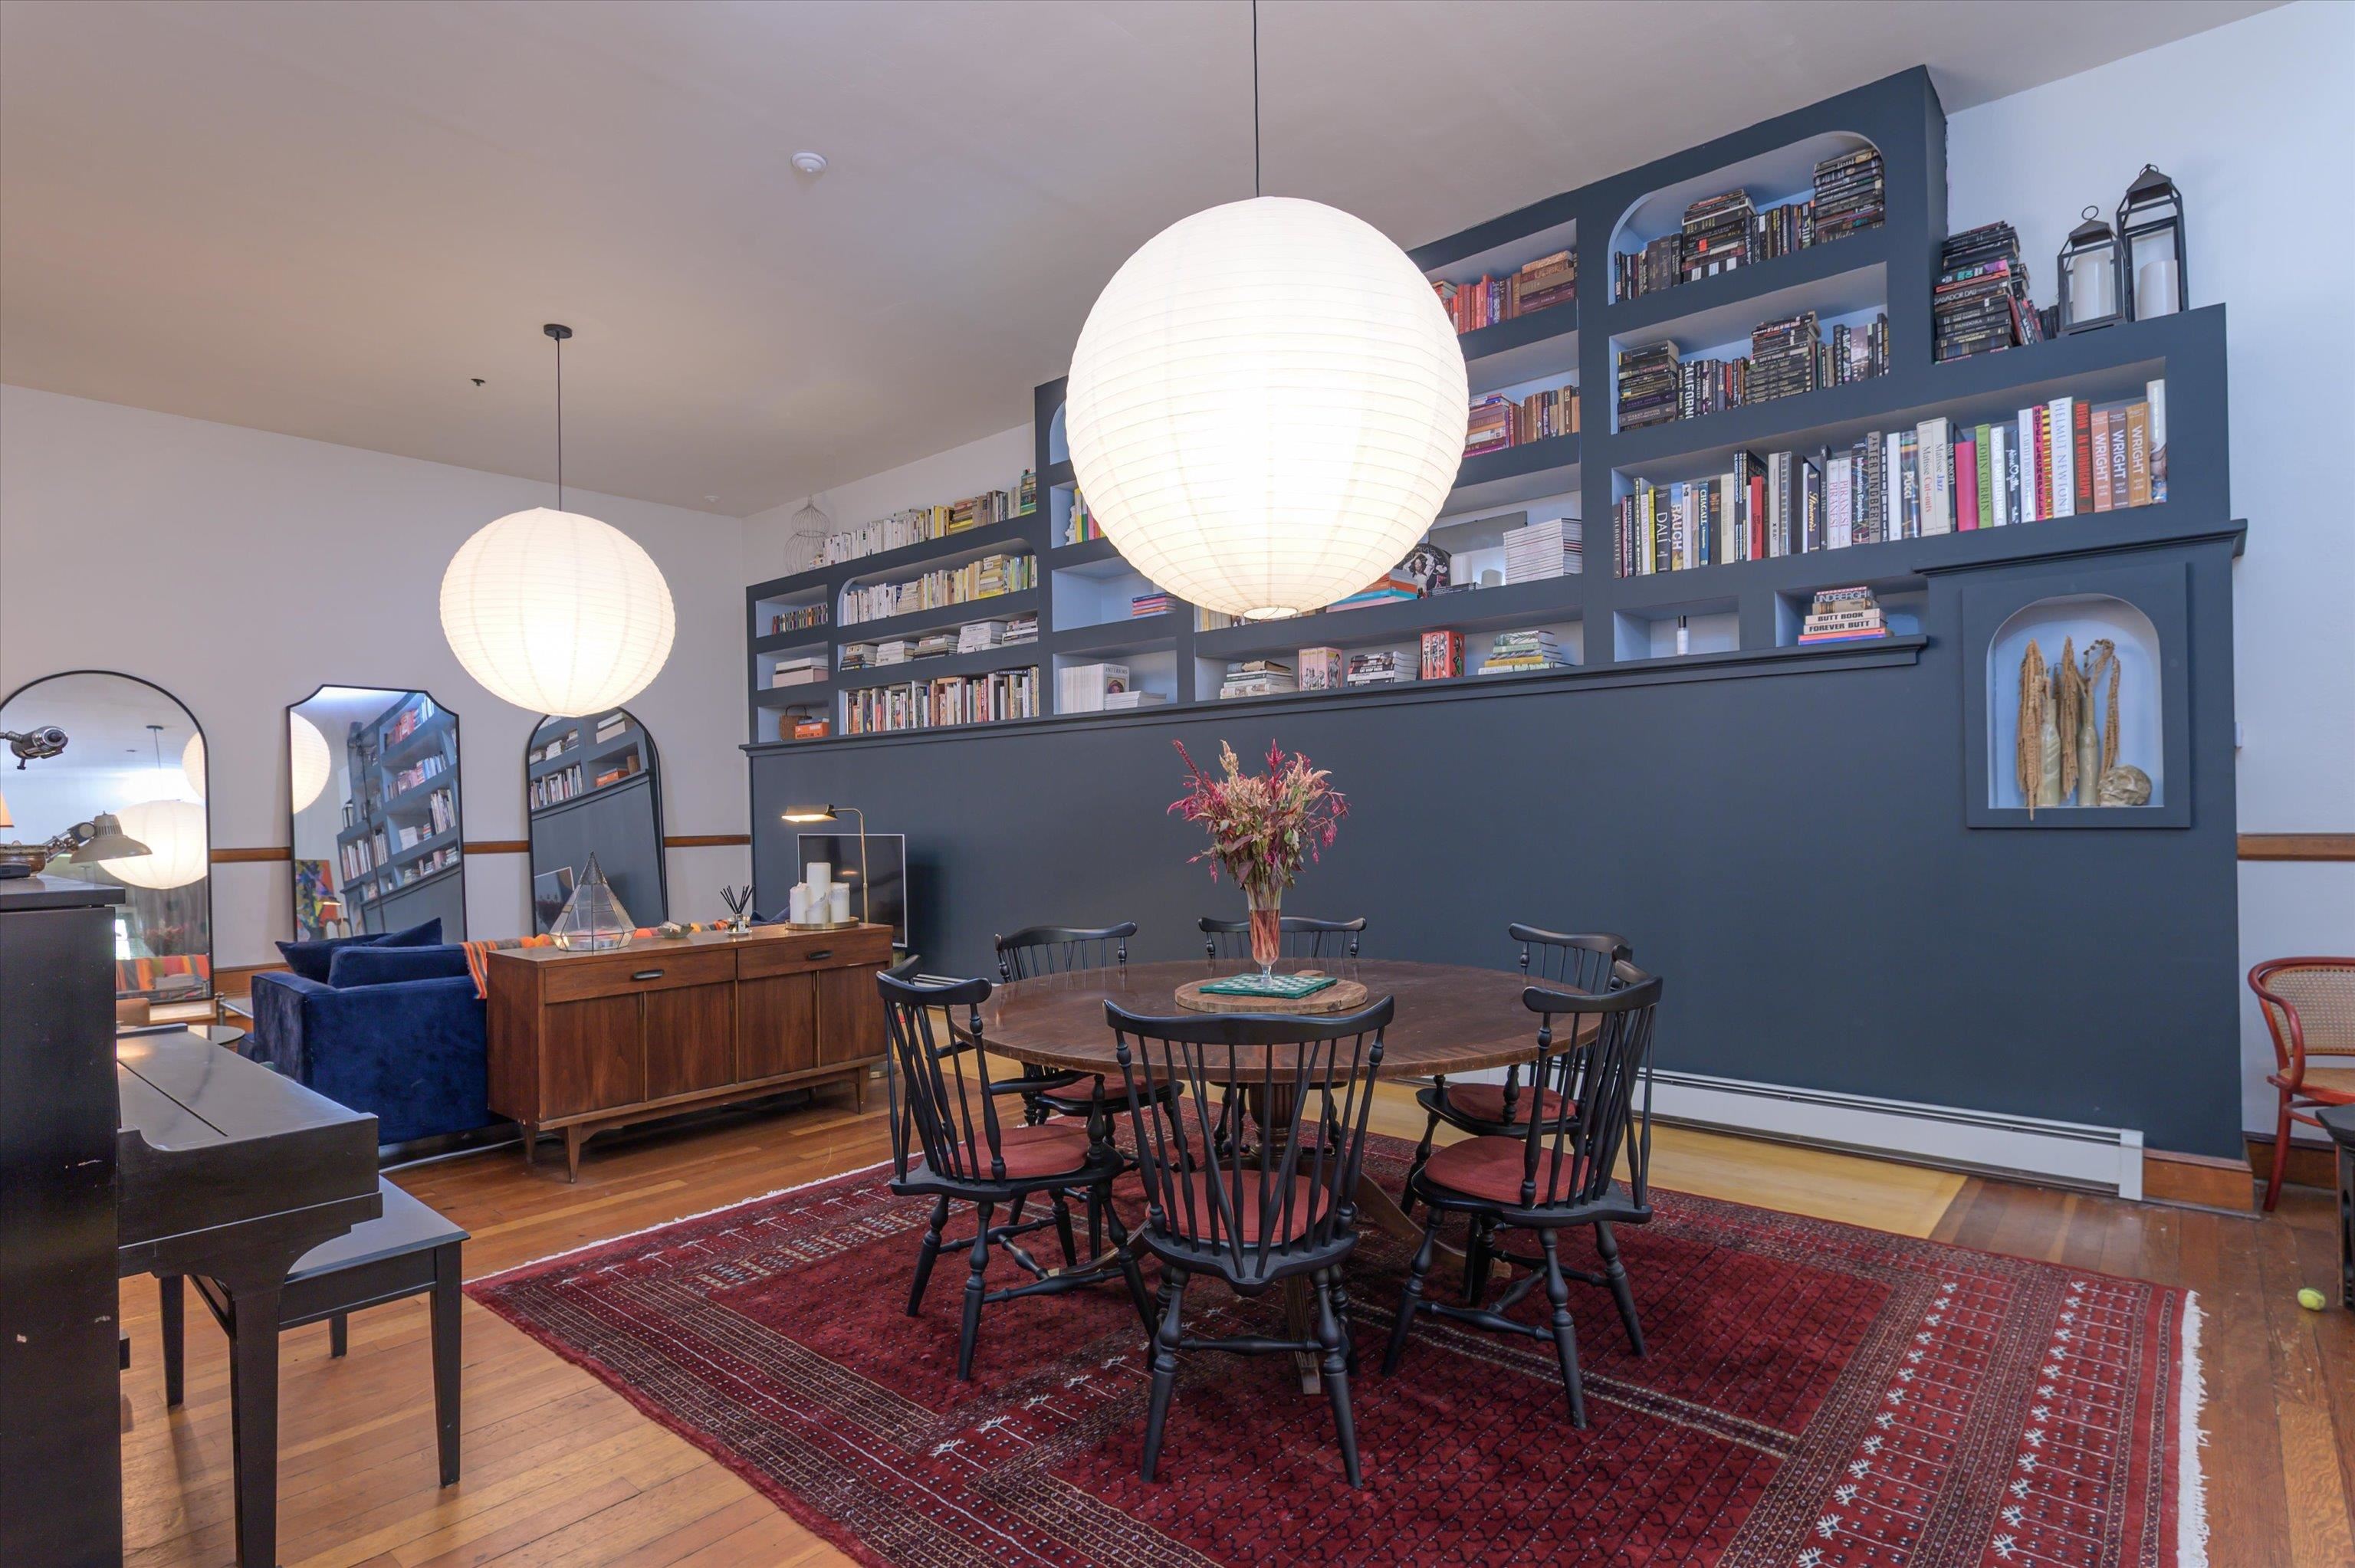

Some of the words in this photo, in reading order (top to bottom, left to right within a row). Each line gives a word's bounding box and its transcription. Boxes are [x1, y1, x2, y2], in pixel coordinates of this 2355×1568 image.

[2055, 402, 2067, 450] HELMUT
[1922, 445, 1931, 476] Matisse
[1935, 442, 1943, 475] Matisse
[1979, 442, 1988, 470] JOHN
[2094, 432, 2107, 482] WRIGHT
[2112, 429, 2126, 478] WRIGHT
[2132, 425, 2144, 474] WRIGHT
[1903, 471, 1915, 499] Pucci
[1936, 474, 1945, 492] Jazz
[2035, 446, 2044, 516] LACHAPELLE
[2057, 454, 2069, 507] NEWTON
[2077, 445, 2091, 498] AUTOBIOGRAPHY
[1700, 489, 1708, 525] CHAGALL
[1829, 482, 1838, 528] PIRANESI
[1840, 480, 1849, 527] PIRANESI
[1923, 477, 1933, 513] Cut-outs
[1979, 472, 1989, 512] CURRIN
[1656, 512, 1671, 543] DALÍ
[1671, 504, 1683, 549] RAUCH
[1814, 590, 1867, 603] LINDBERGH
[1809, 623, 1845, 632] FOREVER
[1848, 620, 1870, 628] BUTT
[1841, 612, 1864, 620] BOOK
